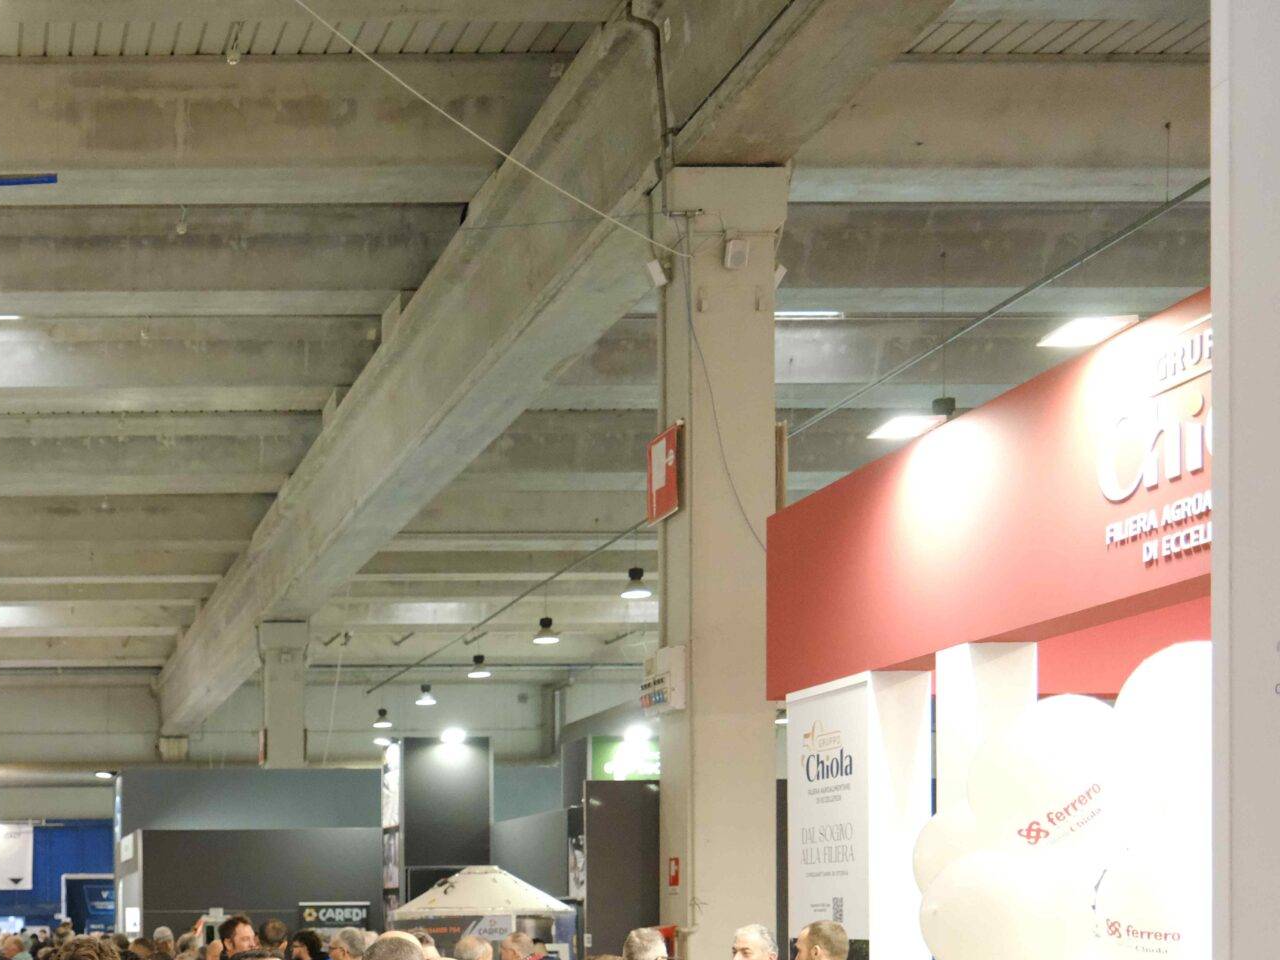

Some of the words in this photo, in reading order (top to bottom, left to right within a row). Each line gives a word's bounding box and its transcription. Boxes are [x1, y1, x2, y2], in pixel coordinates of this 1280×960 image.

[1142, 539, 1158, 564] DI
[806, 747, 853, 782] Chiola
[1046, 784, 1101, 825] ferrero
[801, 827, 817, 845] DAL
[819, 822, 853, 842] SOGNO
[823, 844, 855, 864] FILIERA
[1126, 925, 1181, 942] ferrero
